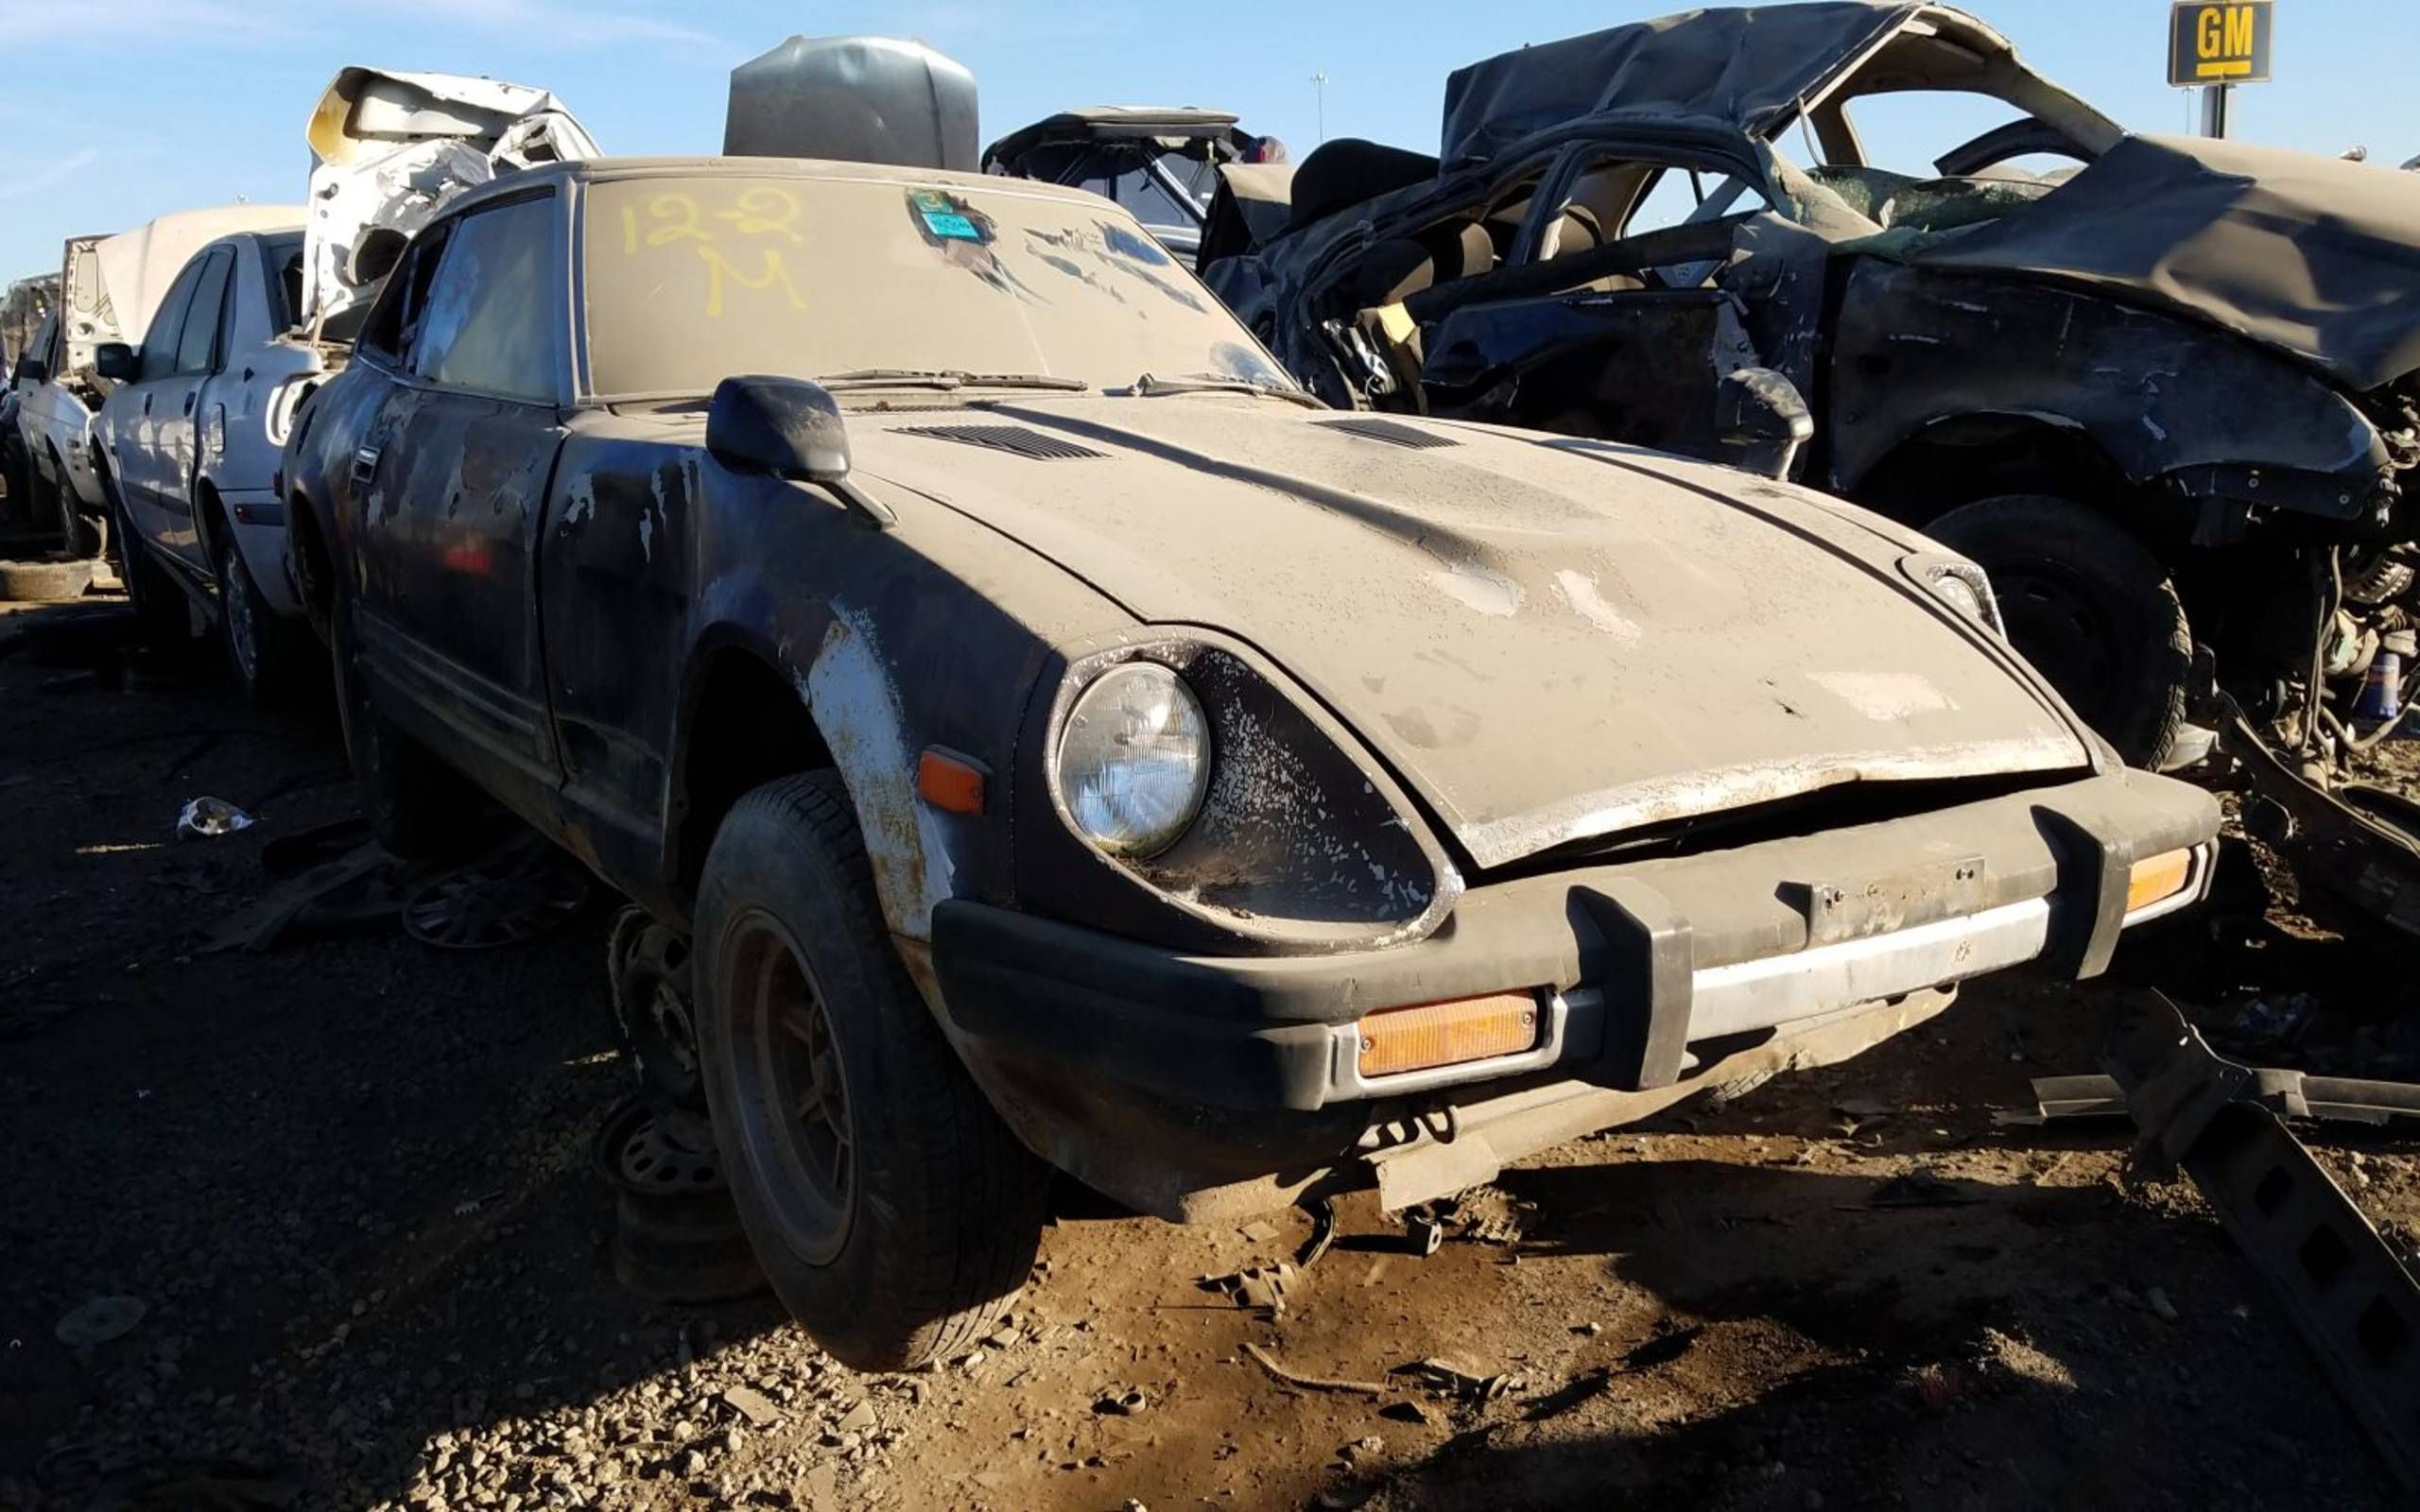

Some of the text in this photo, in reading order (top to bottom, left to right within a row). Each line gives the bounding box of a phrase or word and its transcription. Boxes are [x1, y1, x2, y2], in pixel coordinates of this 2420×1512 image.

[2197, 6, 2254, 59] GM
[621, 188, 804, 255] 12-2
[699, 245, 808, 317] M
